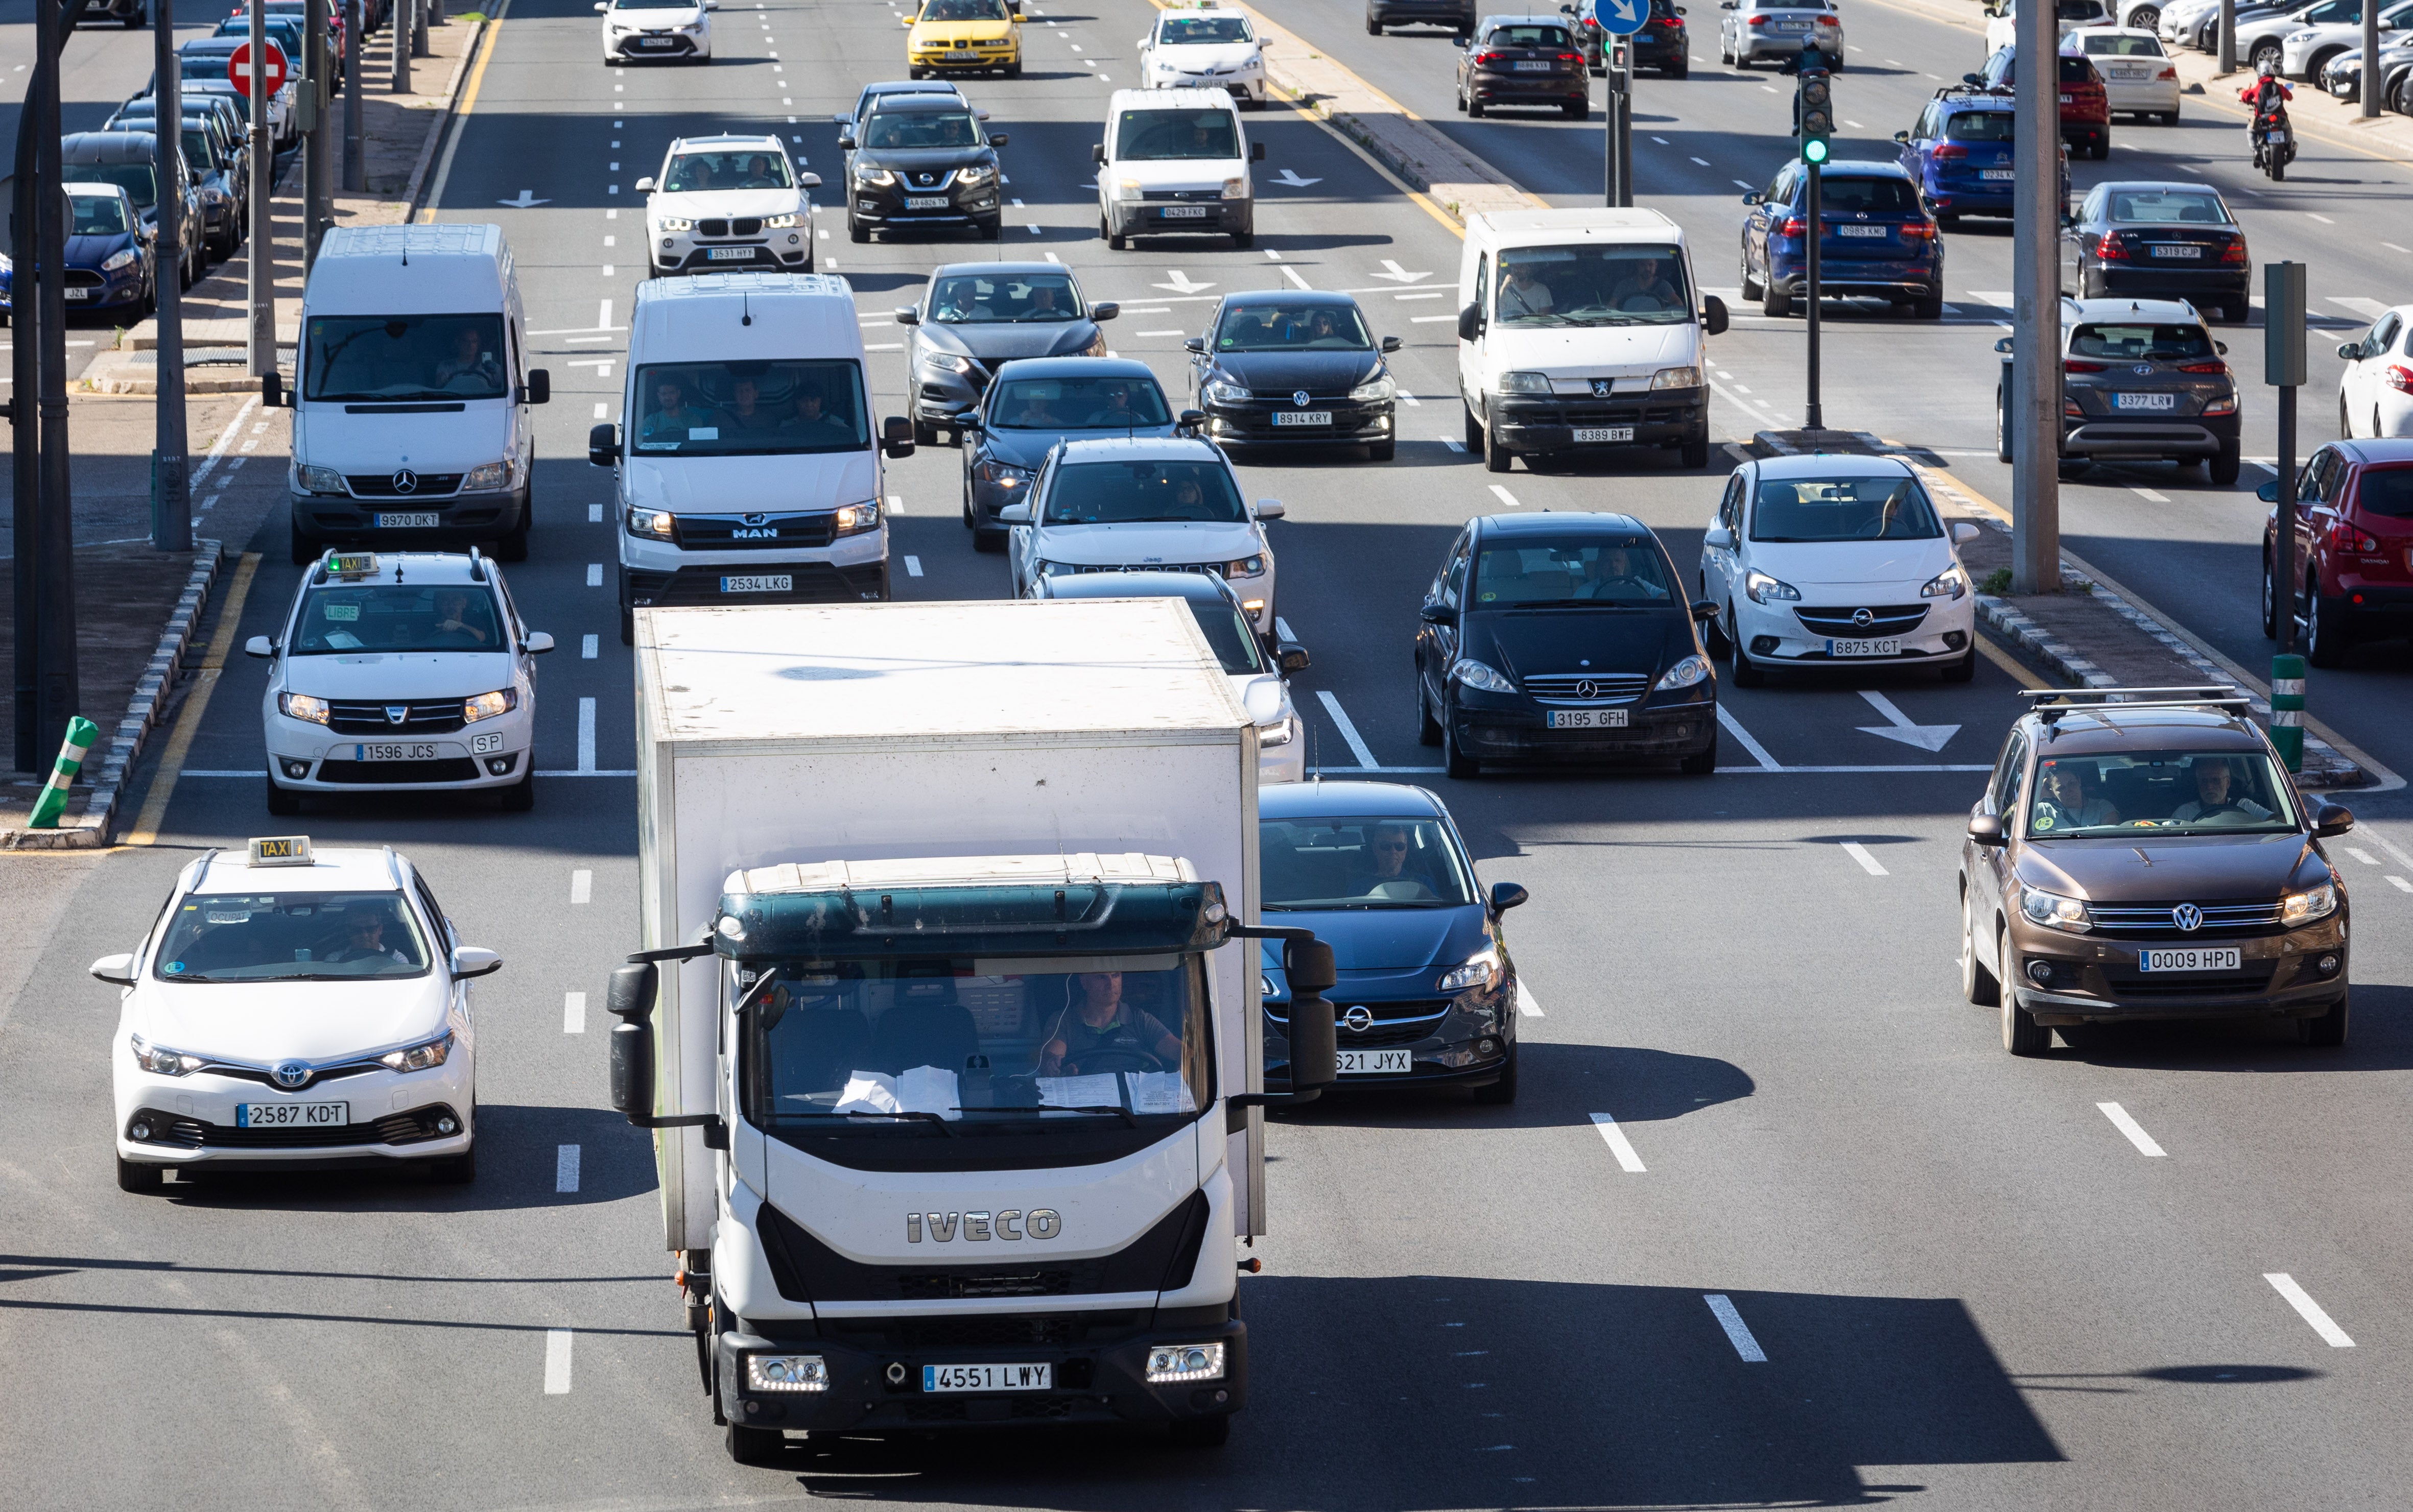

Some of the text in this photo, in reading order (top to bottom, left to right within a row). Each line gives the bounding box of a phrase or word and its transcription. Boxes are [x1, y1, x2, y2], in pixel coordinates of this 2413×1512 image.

[1985, 171, 2004, 179] 0234
[1843, 226, 1885, 235] 0985 KMG
[714, 250, 734, 258] 3531
[2157, 247, 2198, 256] 5319 CJP
[69, 289, 85, 297] JZL
[2119, 395, 2172, 406] 3377 LRW
[1280, 414, 1329, 424] 8914 KRY
[1581, 430, 1631, 440] 8389 BWF
[382, 515, 436, 526] 9970 DKT
[733, 529, 777, 539] MAN
[341, 558, 360, 570] TAXI
[730, 578, 789, 590] 2534 LKG
[328, 607, 356, 618] LIBRE
[1836, 640, 1898, 654] 6875 KCT
[1557, 711, 1625, 726] 3195 GFH
[477, 736, 499, 751] SP
[368, 746, 434, 759] 1596 JCS
[262, 842, 290, 856] TAXI
[211, 912, 246, 921] OCUPAT
[2152, 953, 2196, 968] 0009
[2204, 951, 2236, 967] HPD
[1336, 1053, 1406, 1070] 621 JYX
[252, 1107, 299, 1123] 2587
[307, 1105, 342, 1122] KDT
[908, 1209, 1061, 1243] IVECO
[940, 1368, 992, 1387] 4551
[1004, 1366, 1046, 1386] LWY
